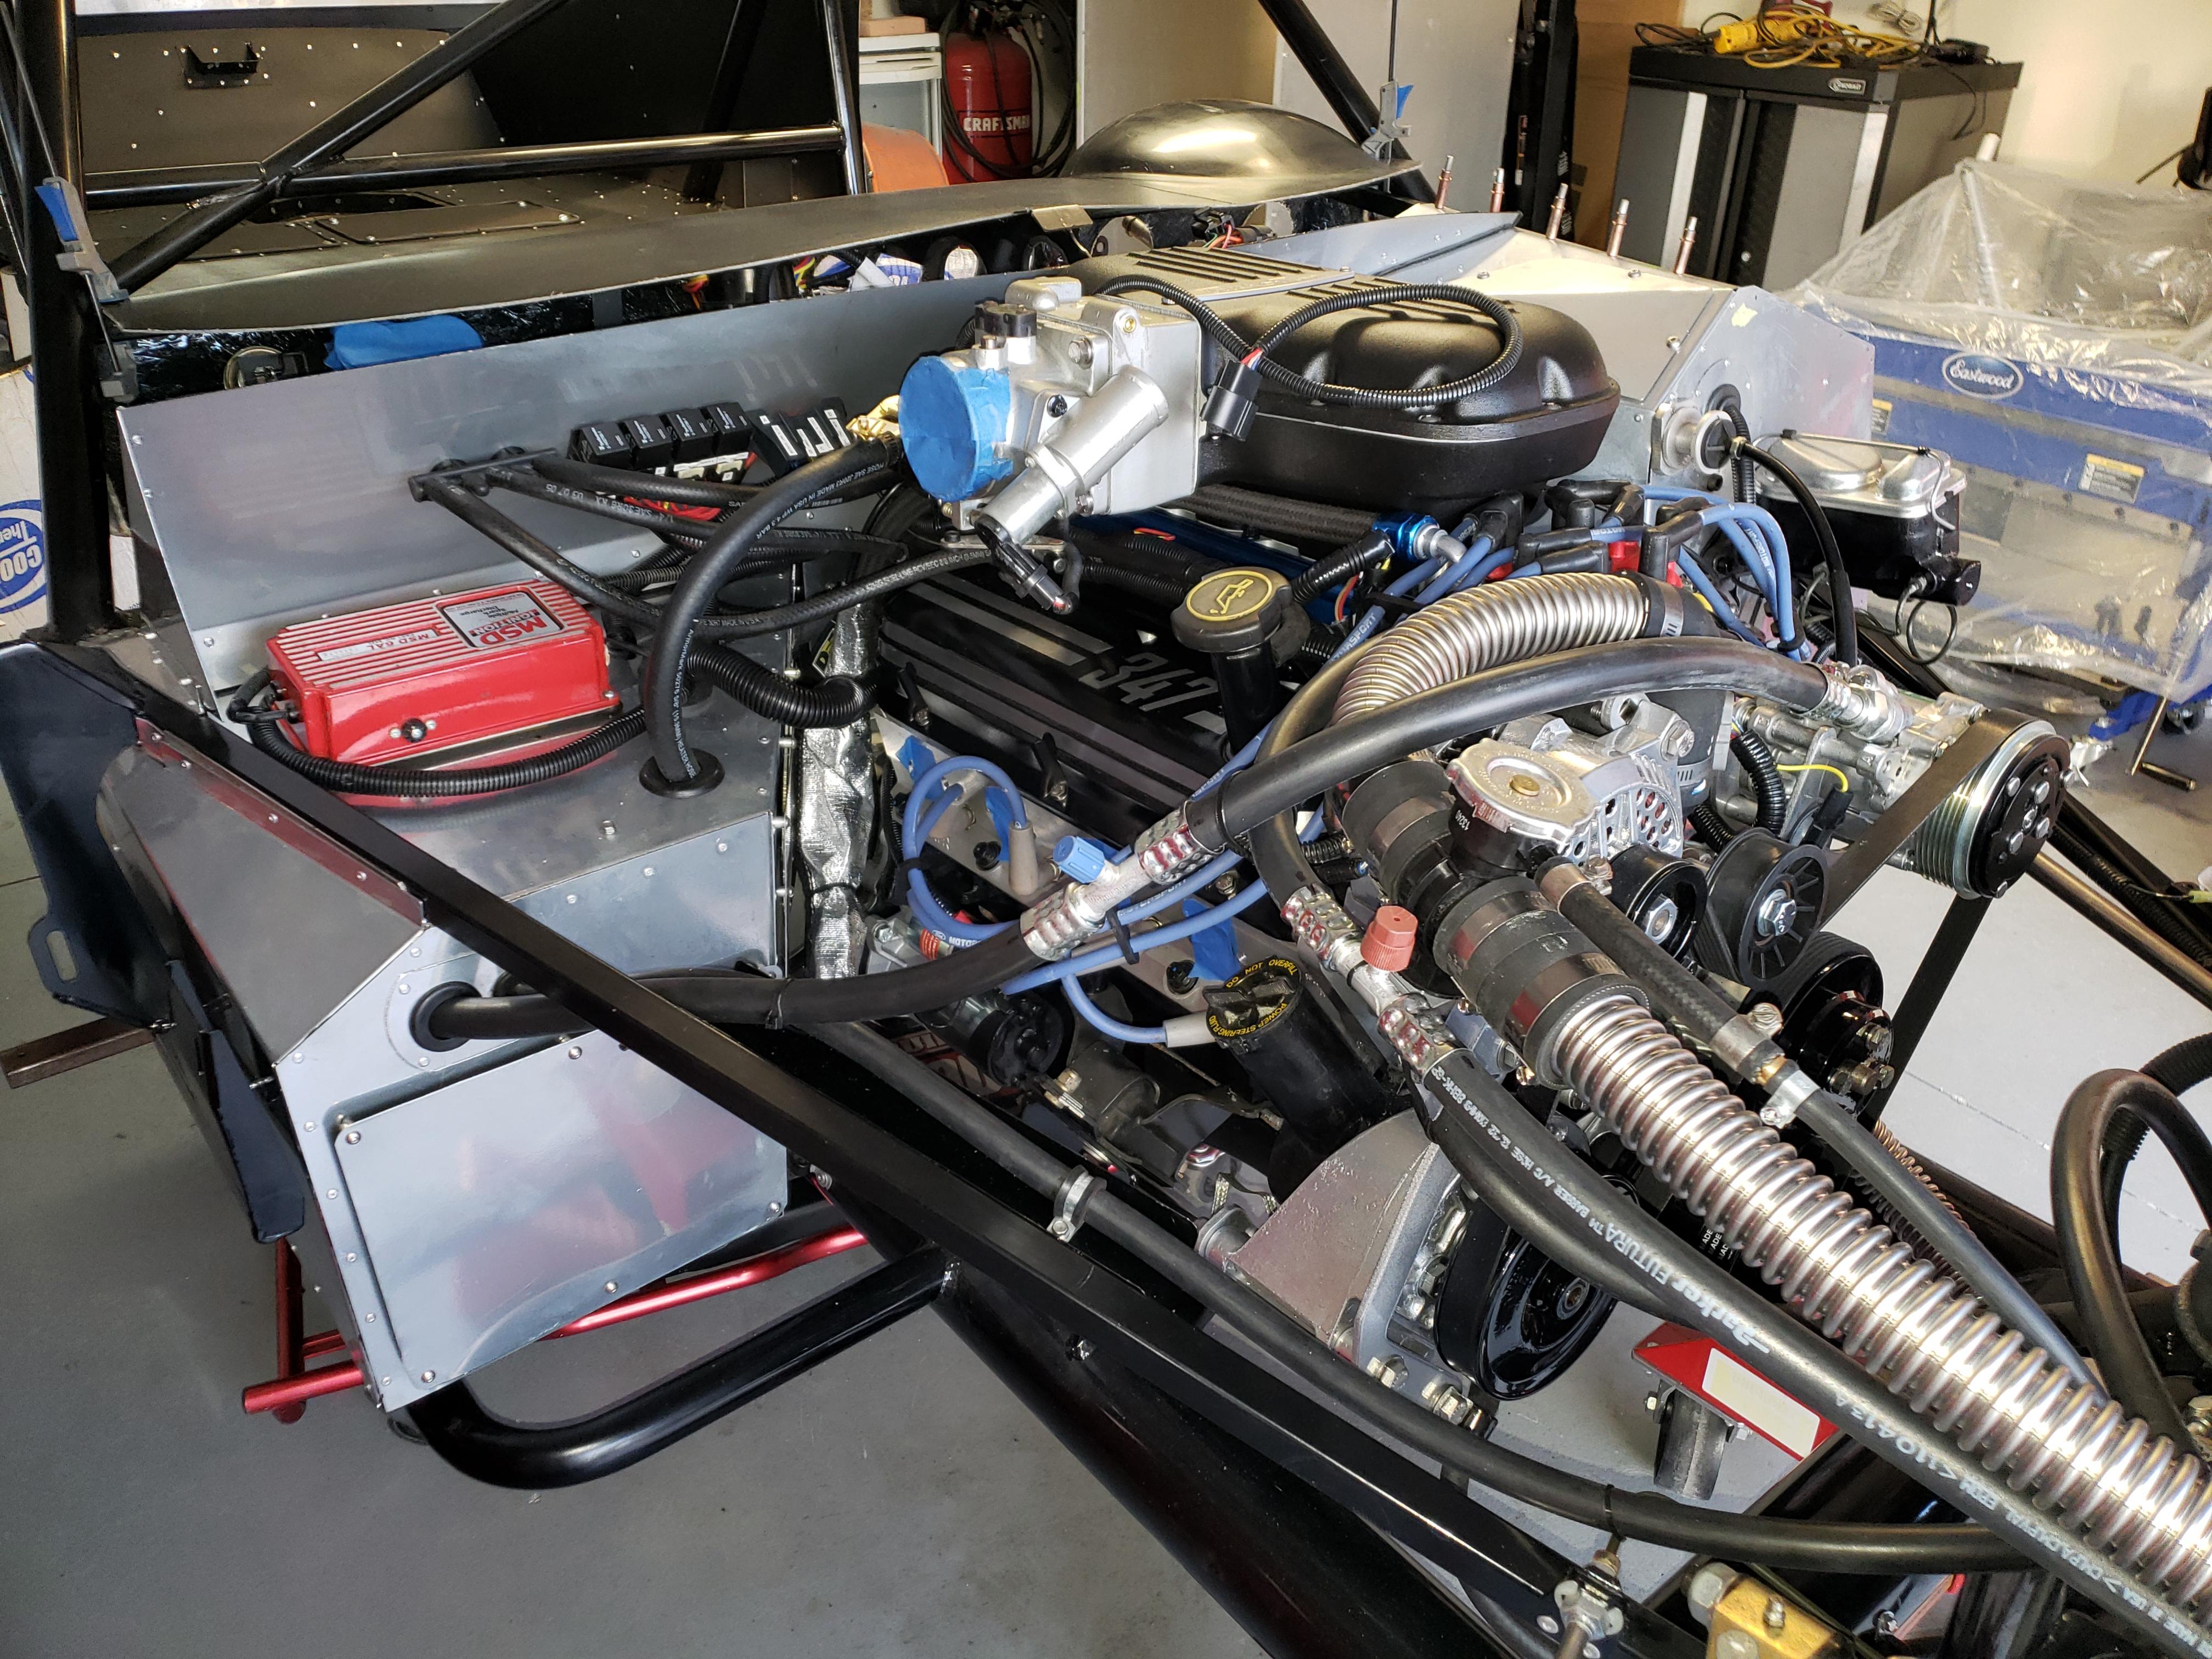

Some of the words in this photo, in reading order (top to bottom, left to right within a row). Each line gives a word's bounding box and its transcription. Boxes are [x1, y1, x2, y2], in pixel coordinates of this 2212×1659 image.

[1950, 359, 2014, 389] Eastwood
[853, 469, 867, 478] SAE
[865, 460, 884, 474] HOSE
[807, 492, 816, 501] IN
[815, 482, 836, 497] MADE
[780, 506, 793, 519] WP
[792, 497, 808, 510] USA
[770, 515, 781, 527] 4.3
[755, 523, 771, 540] BAR
[947, 553, 964, 564] INCH
[459, 605, 498, 616] Discharge
[472, 609, 539, 636] IGNITION
[479, 617, 548, 646] MSD
[397, 633, 429, 644] MSD
[676, 628, 694, 671] ArmorMark
[1078, 652, 1219, 712] 347
[675, 740, 688, 764] HEATER
[1455, 809, 1471, 830] 13240
[1226, 976, 1239, 988] DO
[1245, 962, 1264, 975] NOT
[1269, 959, 1298, 975] OVERFILL
[1208, 1015, 1220, 1032] FLUID
[1258, 1003, 1288, 1028] POWER
[1218, 1025, 1256, 1037] STEERING
[1509, 1145, 1535, 1171] HOSE
[1530, 1165, 1556, 1189] A/C
[1551, 1183, 1591, 1218] BARRIER
[1669, 1273, 1755, 1346] Parker
